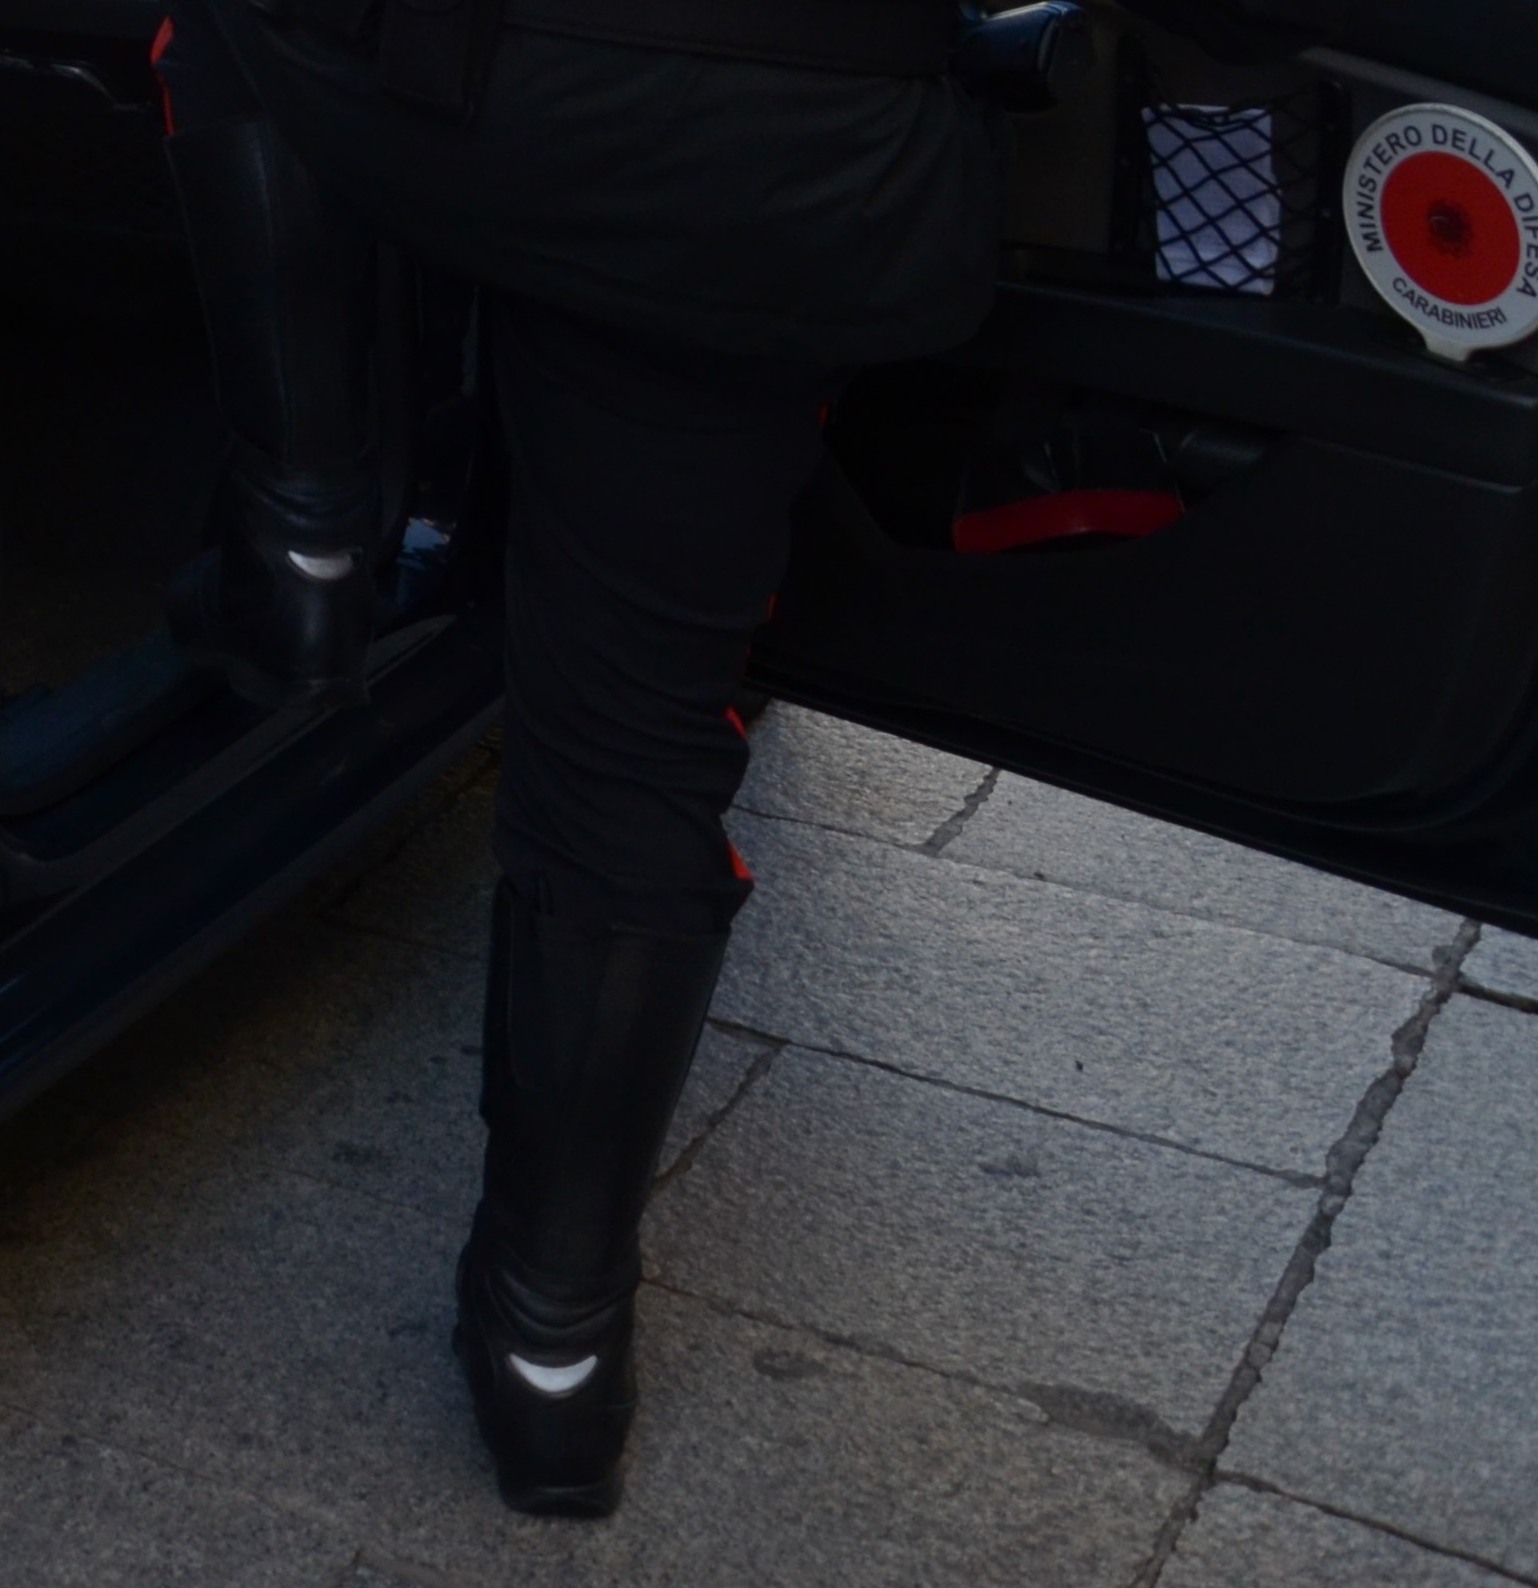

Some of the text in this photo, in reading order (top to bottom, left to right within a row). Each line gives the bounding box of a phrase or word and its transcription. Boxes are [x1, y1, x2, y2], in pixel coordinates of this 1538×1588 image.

[1357, 124, 1538, 298] MINISTERO DELLA DIFESA
[1392, 277, 1507, 330] CARABINIERI
